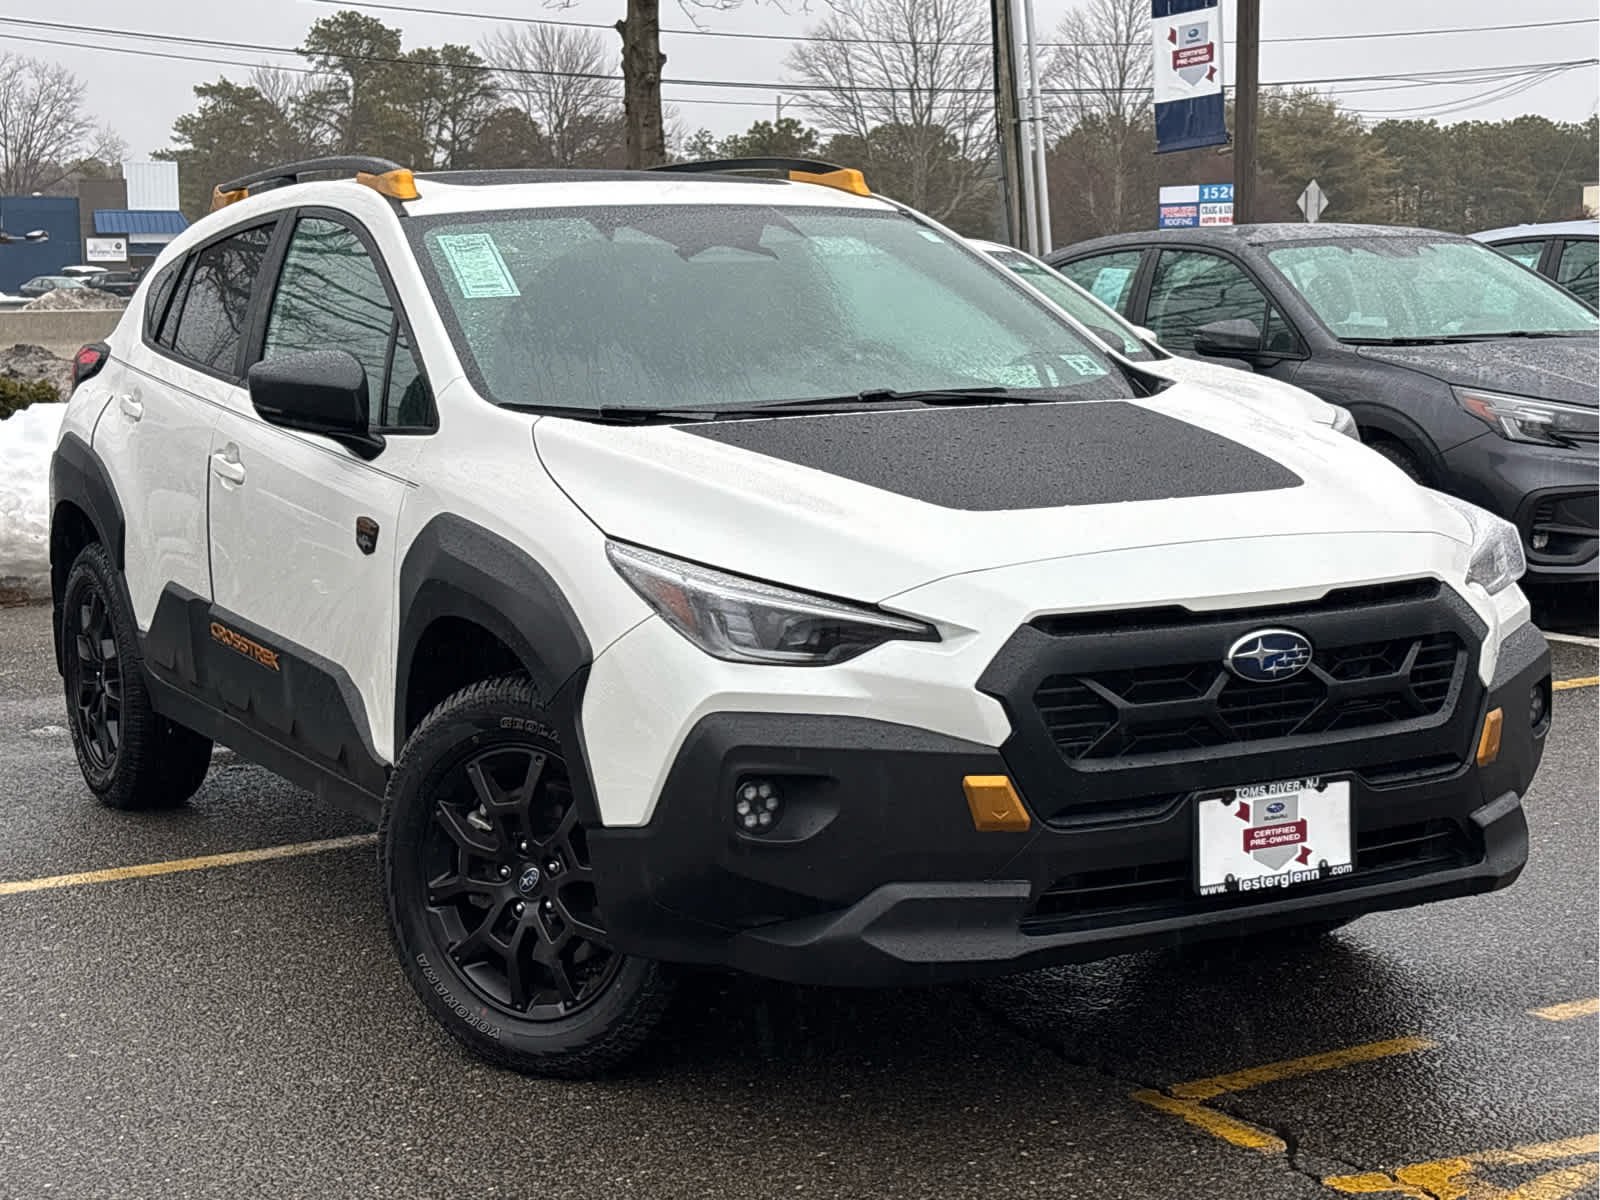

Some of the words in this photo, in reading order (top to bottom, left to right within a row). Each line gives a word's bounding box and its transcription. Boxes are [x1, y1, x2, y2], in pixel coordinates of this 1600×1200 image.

[1178, 47, 1208, 57] CERTIFIED
[1164, 217, 1193, 226] ROOFING
[210, 621, 280, 671] CROSSTREK
[1235, 785, 1266, 799] TOMS
[1268, 780, 1304, 794] RIVER,
[1305, 776, 1320, 789] NJ
[1249, 833, 1301, 847] PRE-OWNED
[1253, 825, 1296, 838] CERTIFIED
[1200, 884, 1228, 896] www.
[1238, 868, 1320, 892] lesterglenn
[1329, 863, 1353, 876] .com
[416, 952, 501, 1040] YOKOHAMA
